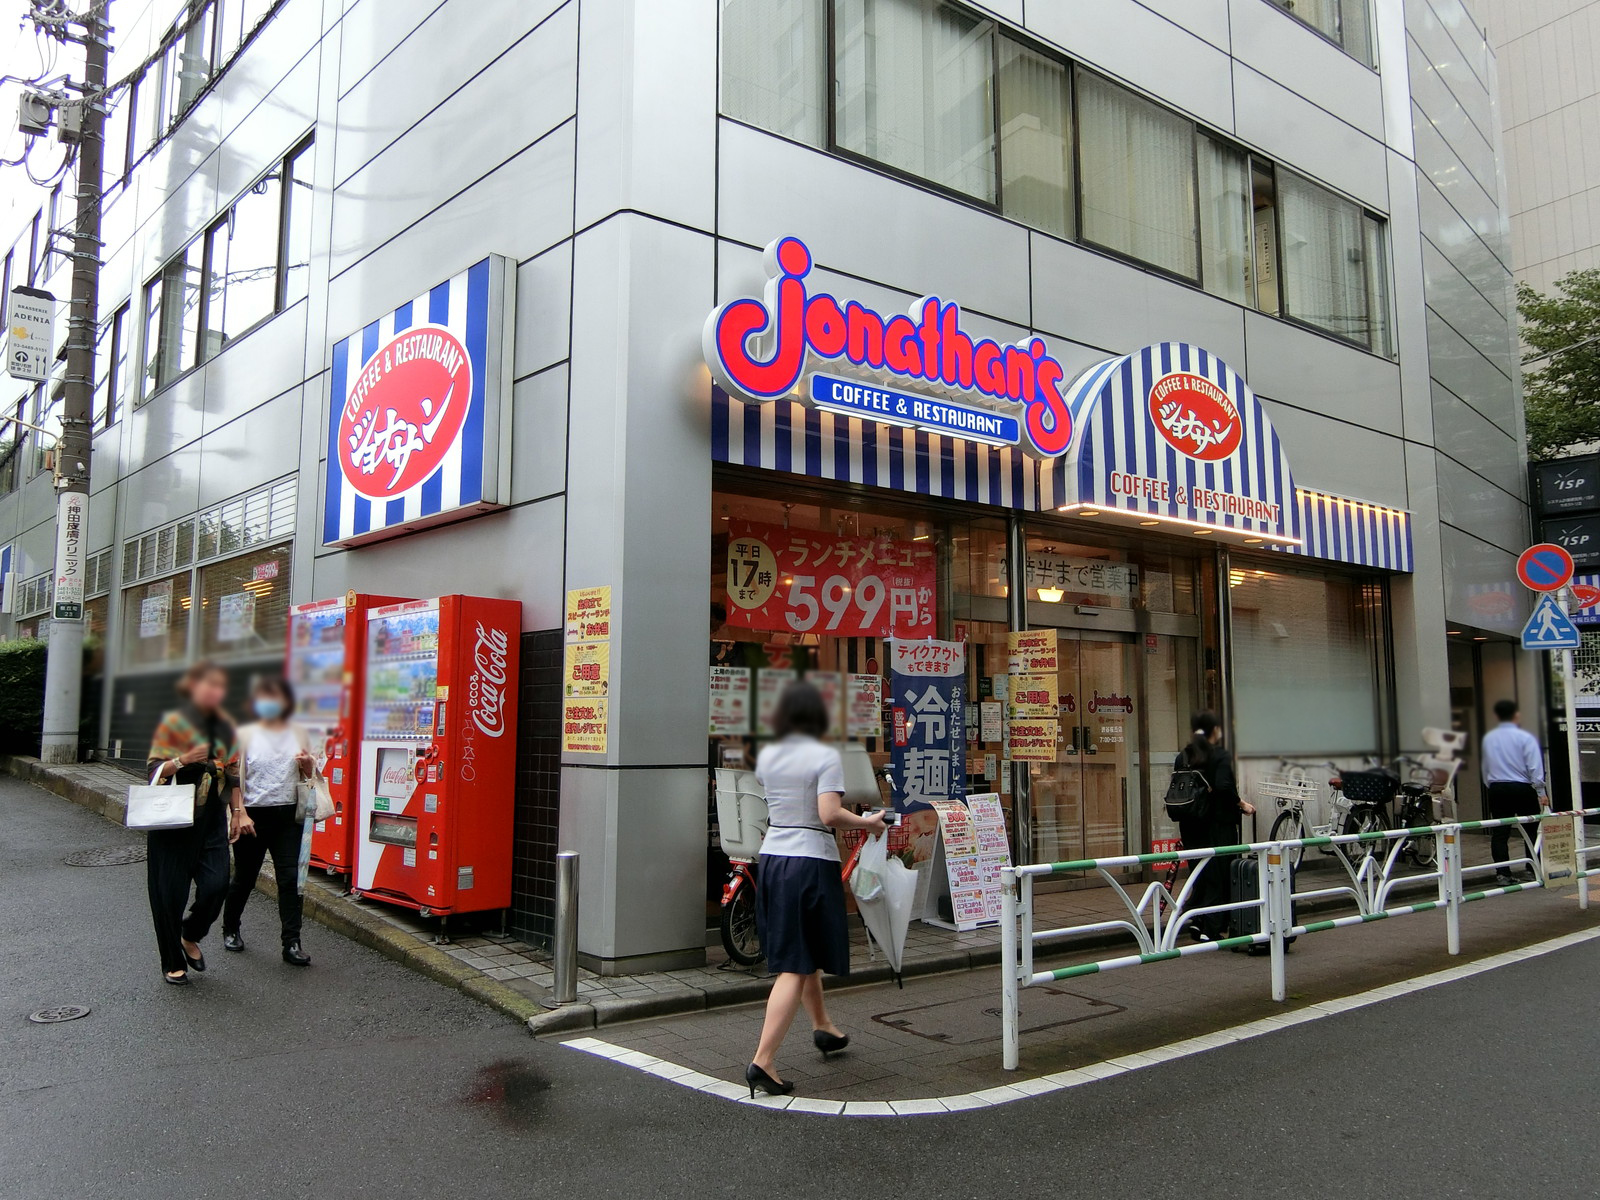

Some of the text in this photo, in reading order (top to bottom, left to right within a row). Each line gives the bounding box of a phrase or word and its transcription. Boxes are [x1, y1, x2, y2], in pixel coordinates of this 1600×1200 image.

[14, 312, 50, 325] ADENIA
[346, 333, 464, 423] COFFEE & RESTAURANT
[832, 382, 1003, 435] COFFEE & RESTAURANT
[1154, 376, 1237, 421] COFFEE & RESTAURANT
[1111, 472, 1280, 524] COFFEE & RESTAURANT
[65, 506, 81, 576] 押田皮膚クリニック
[736, 543, 760, 558] 平日
[788, 537, 933, 569] ランチメニュー
[730, 558, 772, 588] 17時
[738, 589, 756, 600] まで
[586, 622, 609, 636] お弁当
[897, 645, 960, 662] テイクアウト
[908, 661, 950, 673] もできます
[1030, 657, 1057, 668] お弁当
[472, 620, 508, 738] Coca-Cola
[572, 662, 601, 680] ご用意
[1015, 691, 1050, 704] ご用意
[904, 685, 950, 808] 冷麺
[950, 686, 962, 795] お待たせしました
